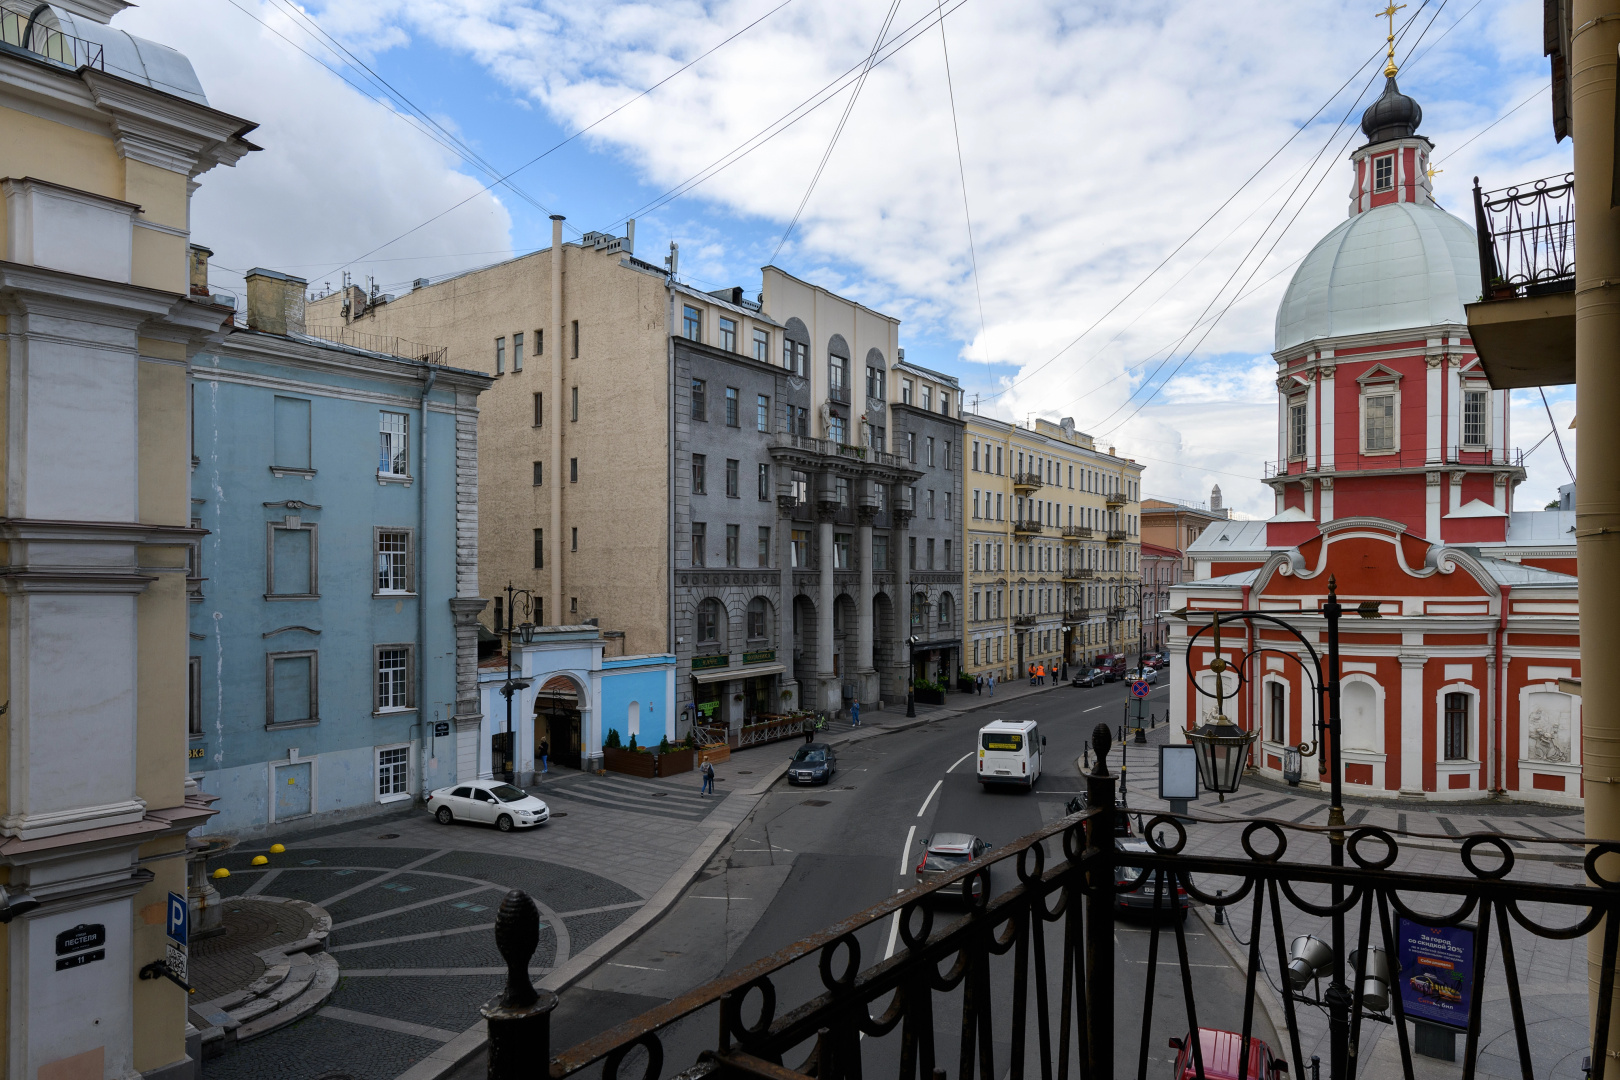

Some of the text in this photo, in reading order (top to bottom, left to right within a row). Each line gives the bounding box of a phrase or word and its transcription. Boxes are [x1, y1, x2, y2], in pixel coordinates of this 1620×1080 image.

[172, 900, 183, 934] P
[65, 934, 97, 947] ПЕСТЕЛЯ
[1417, 940, 1446, 950] скидкой
[1431, 937, 1451, 945] город
